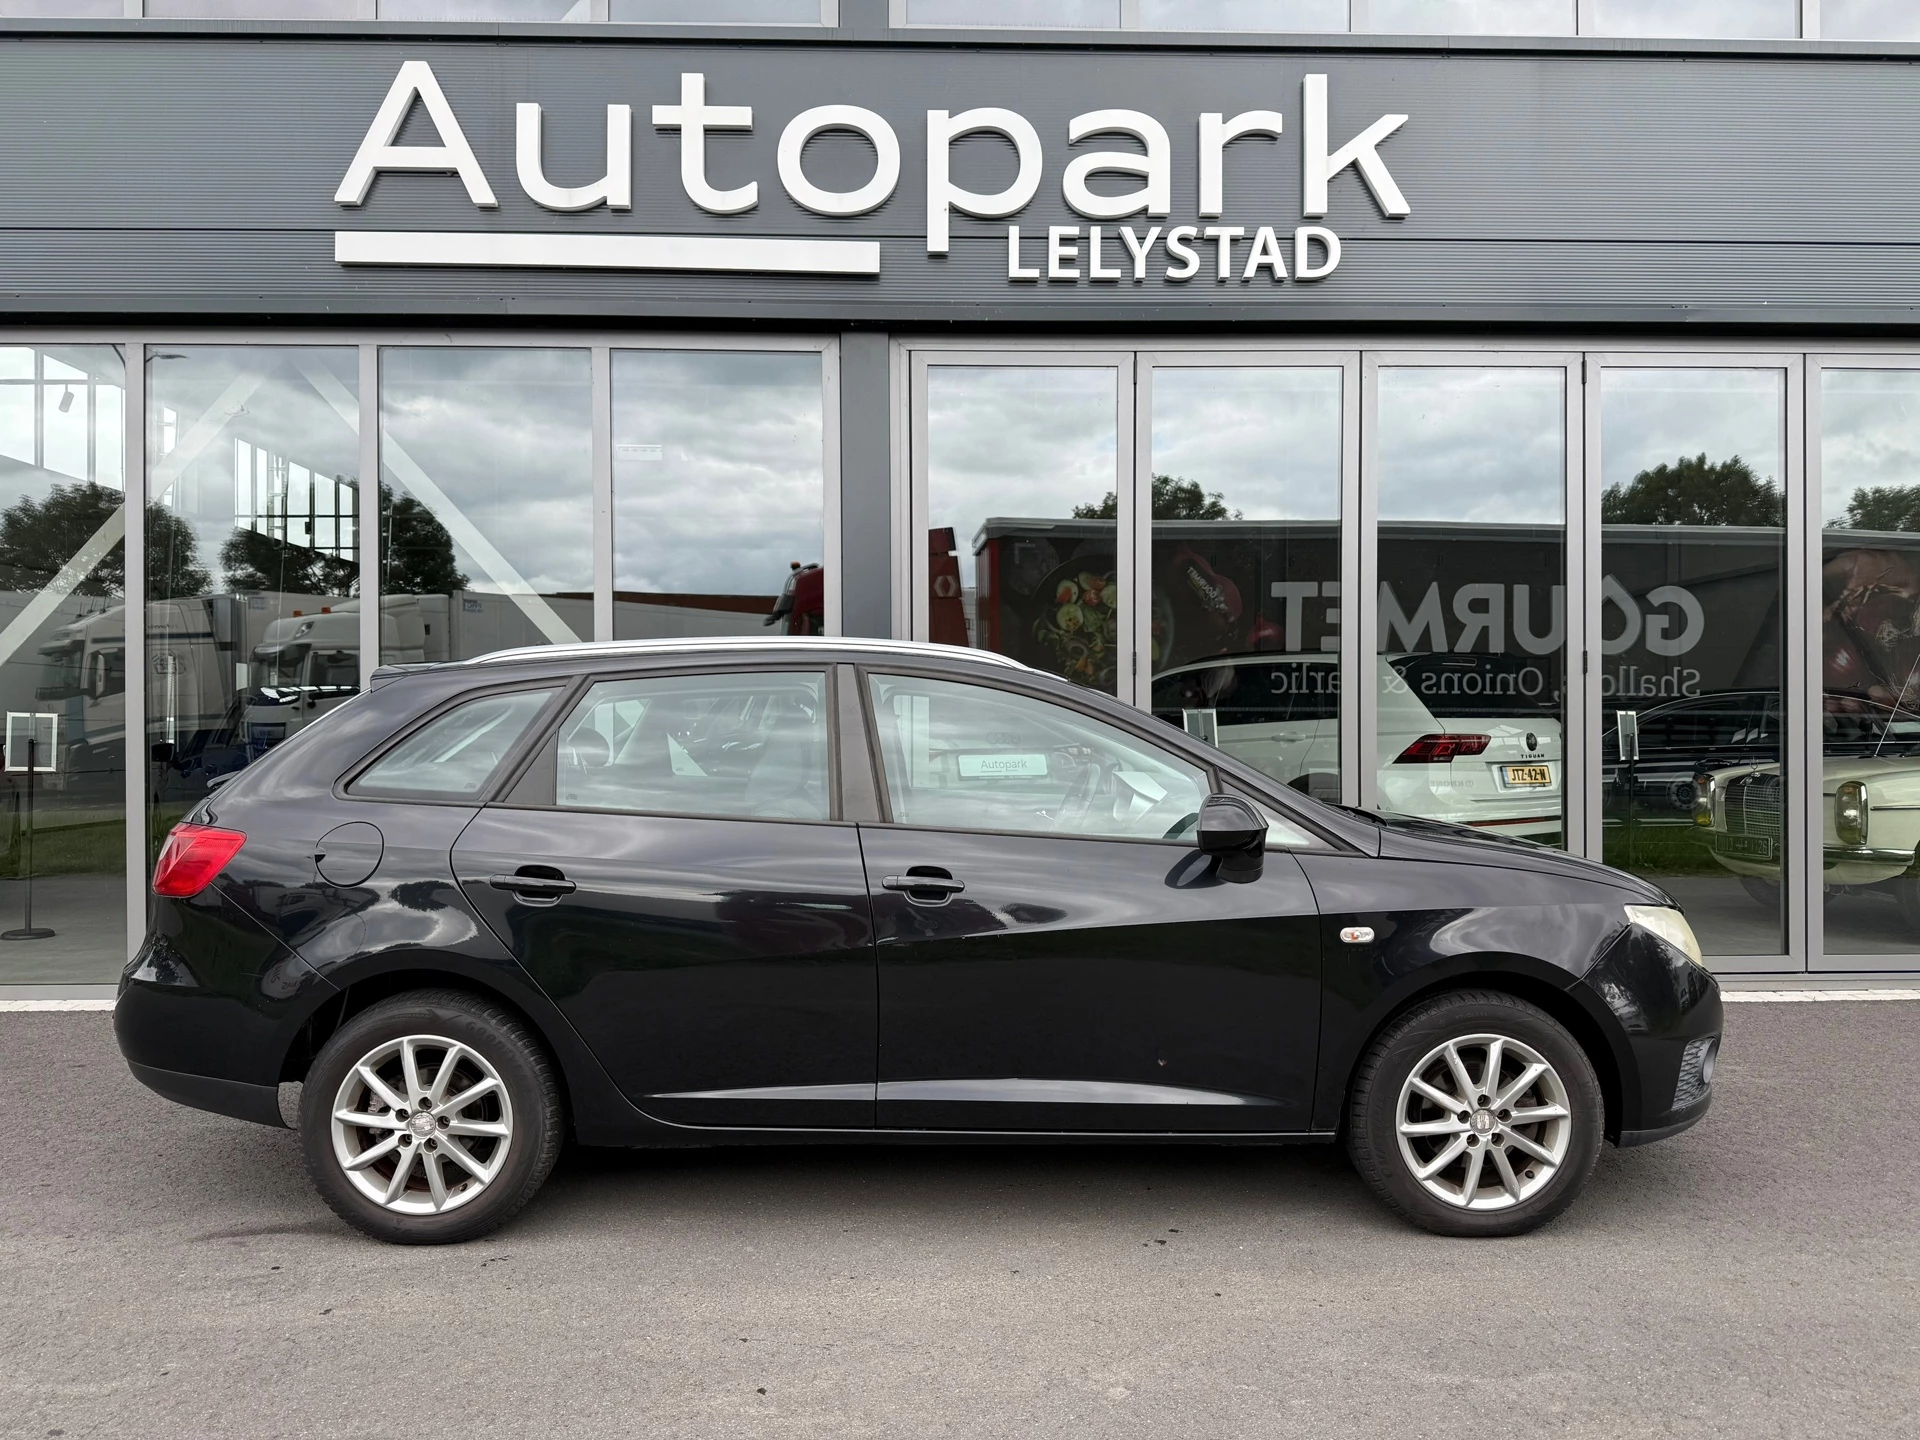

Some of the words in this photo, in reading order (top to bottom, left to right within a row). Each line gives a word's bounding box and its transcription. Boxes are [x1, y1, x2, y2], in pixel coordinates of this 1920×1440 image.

[334, 59, 1411, 256] Autopark
[1007, 224, 1343, 283] LELYSTAD
[980, 759, 1028, 770] Autopark
[1511, 768, 1547, 782] JTZ-42-N
